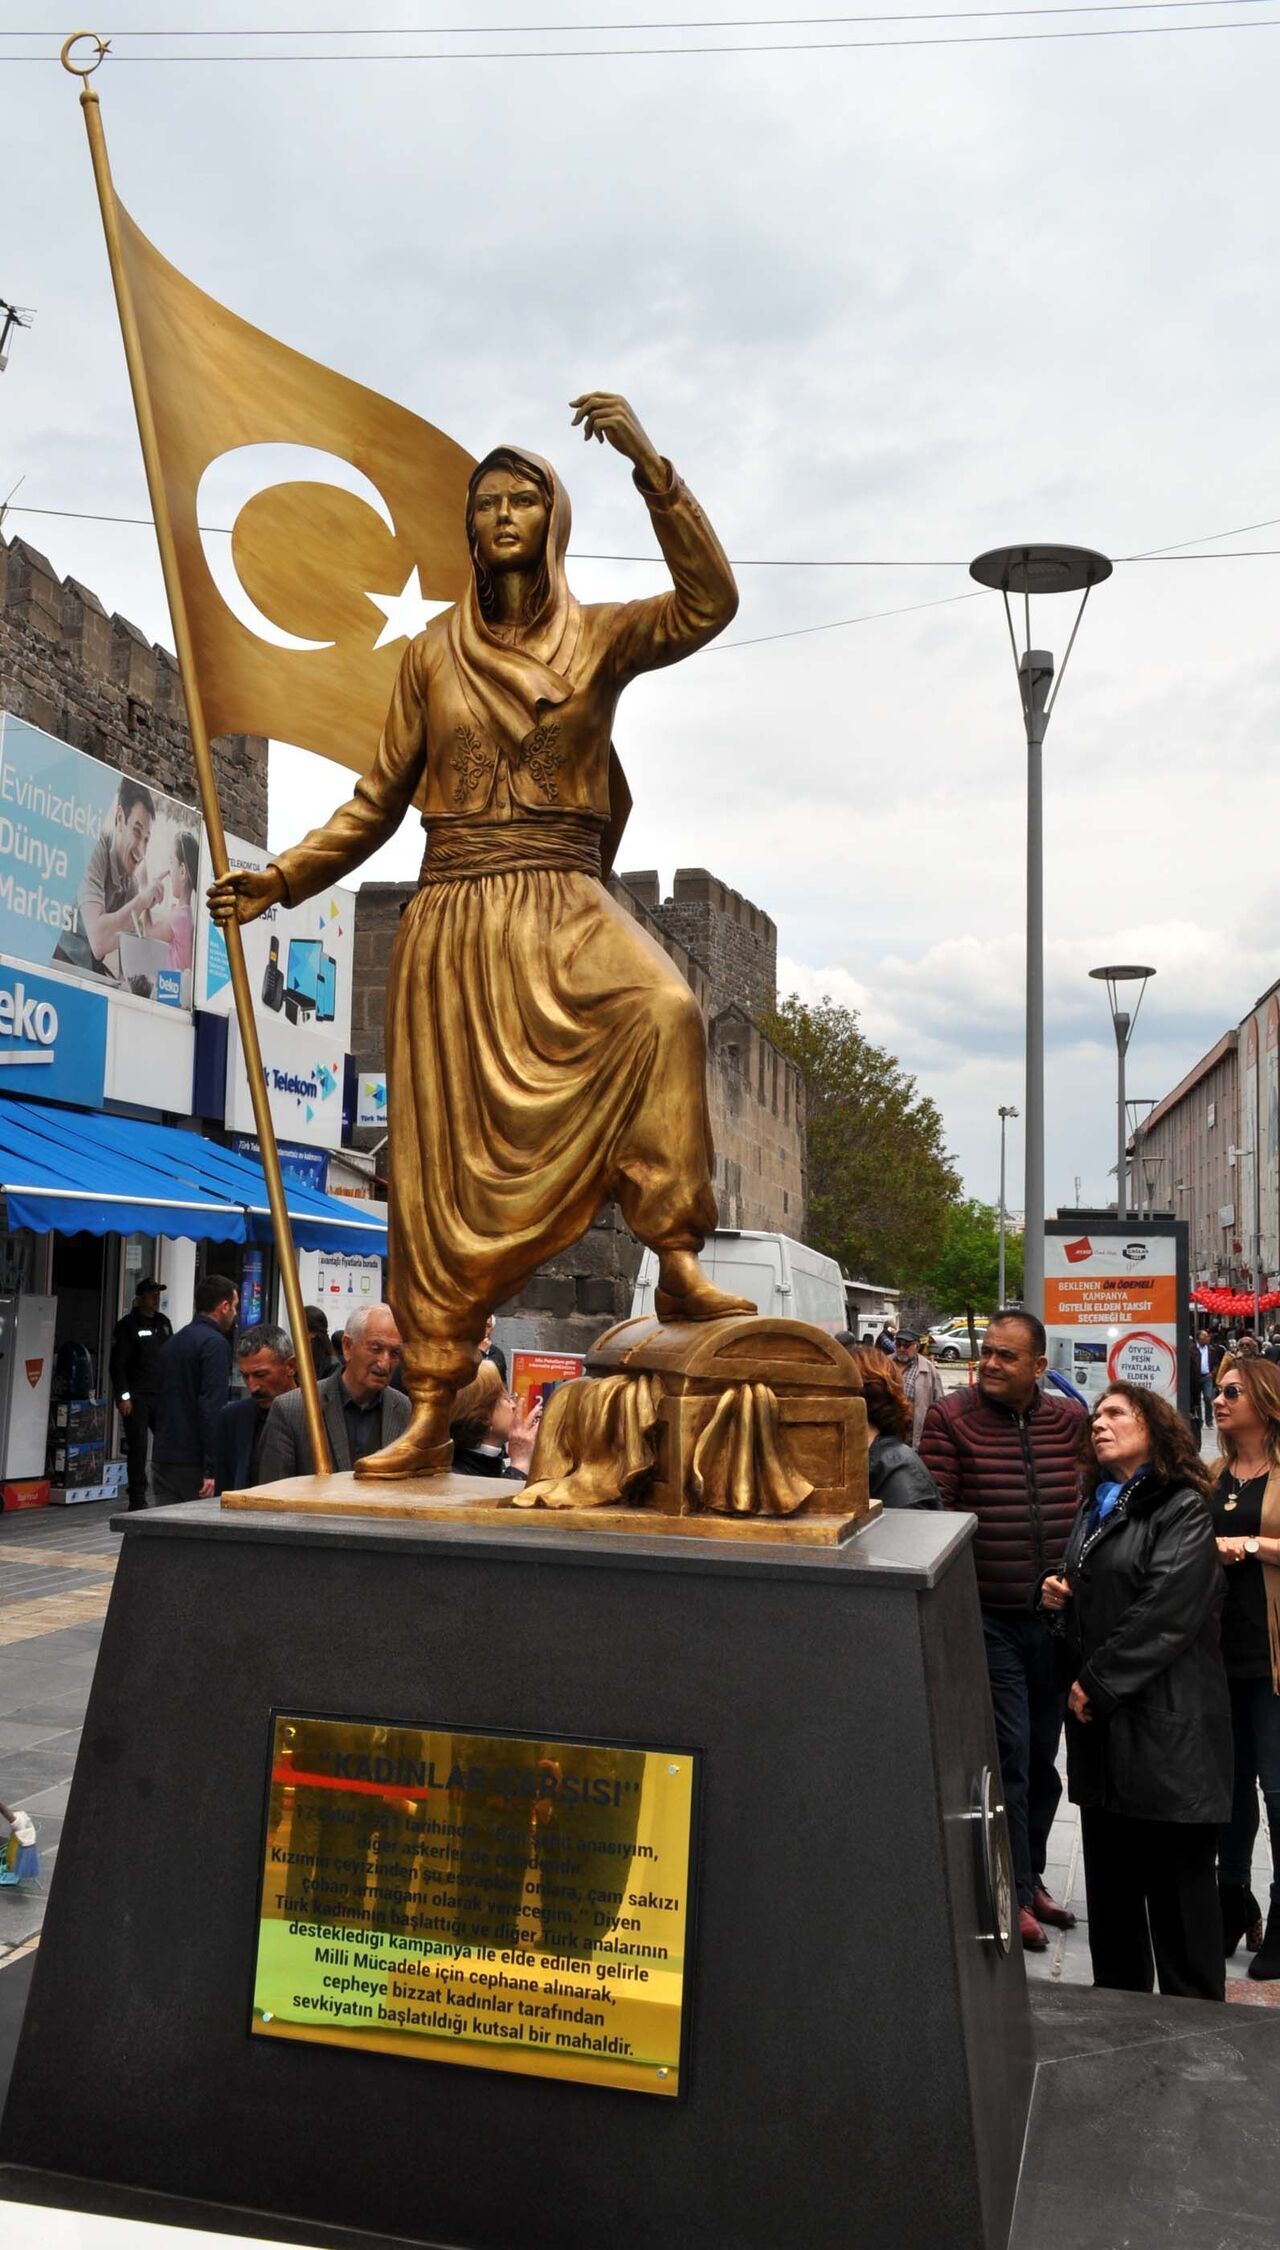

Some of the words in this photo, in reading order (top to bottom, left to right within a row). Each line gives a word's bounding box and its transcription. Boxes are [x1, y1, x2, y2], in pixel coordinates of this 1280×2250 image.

[1, 764, 101, 841] Evinizdeki
[0, 816, 68, 880] Dünya
[0, 872, 78, 933] Markası
[159, 975, 179, 994] beko
[0, 982, 59, 1045] eko
[273, 1069, 317, 1098] Telekom
[1059, 1282, 1100, 1291] BEKLENEN
[1103, 1280, 1115, 1289] ÖN
[1118, 1280, 1154, 1289] ÖDEMELİ
[1059, 1301, 1092, 1312] ÜSTELİK
[1094, 1302, 1120, 1311] ELDEN
[1123, 1300, 1152, 1311] TAKSİT
[1083, 1292, 1128, 1301] KAMPANYA
[1078, 1312, 1118, 1323] SEÇENEĞİ
[1119, 1312, 1132, 1322] İLE
[1121, 1363, 1160, 1372] FİYATLARLA
[1128, 1345, 1154, 1354] ÖTV'SİZ
[1131, 1355, 1151, 1363] PEŞİN
[401, 1841, 465, 1862] askerler
[405, 1814, 478, 1840] tarihinde
[577, 1838, 659, 1862] anasıyım,
[271, 1848, 329, 1868] Kızımın
[336, 1855, 418, 1880] çeyizinden
[424, 1869, 441, 1885] şu
[525, 1880, 582, 1902] onlara,
[588, 1888, 623, 1906] çam
[628, 1891, 679, 1911] sakızı
[301, 1876, 348, 1894] çoban
[353, 1884, 428, 1906] armağanı
[432, 1891, 483, 1911] olarak
[593, 1911, 641, 1932] Diyen
[275, 1894, 308, 1913] Türk
[313, 1899, 388, 1922] kadınının
[391, 1908, 465, 1935] başlattığı
[471, 1923, 489, 1937] ve
[495, 1923, 537, 1944] diğer
[542, 1930, 578, 1949] Türk
[583, 1937, 668, 1960] analarının
[289, 1921, 384, 1950] desteklediği
[389, 1934, 472, 1961] kampanya
[477, 1944, 496, 1961] ile
[501, 1949, 536, 1968] elde
[541, 1954, 591, 1975] edilen
[596, 1962, 649, 1982] gelirle
[315, 1947, 349, 1966] Milli
[353, 1952, 431, 1977] Mücadele
[435, 1962, 464, 1985] için
[469, 1971, 539, 1992] cephane
[543, 1979, 616, 2006] alınarak,
[323, 1974, 388, 1997] cepheye
[393, 1981, 442, 2003] bizzat
[446, 1989, 513, 2014] kadınlar
[518, 1999, 605, 2026] tarafından
[292, 1994, 373, 2018] sevkiyatın
[378, 2003, 468, 2035] başlatıldığı
[473, 2017, 523, 2040] kutsal
[528, 2023, 551, 2043] bir
[556, 2032, 634, 2056] mahaldir.
